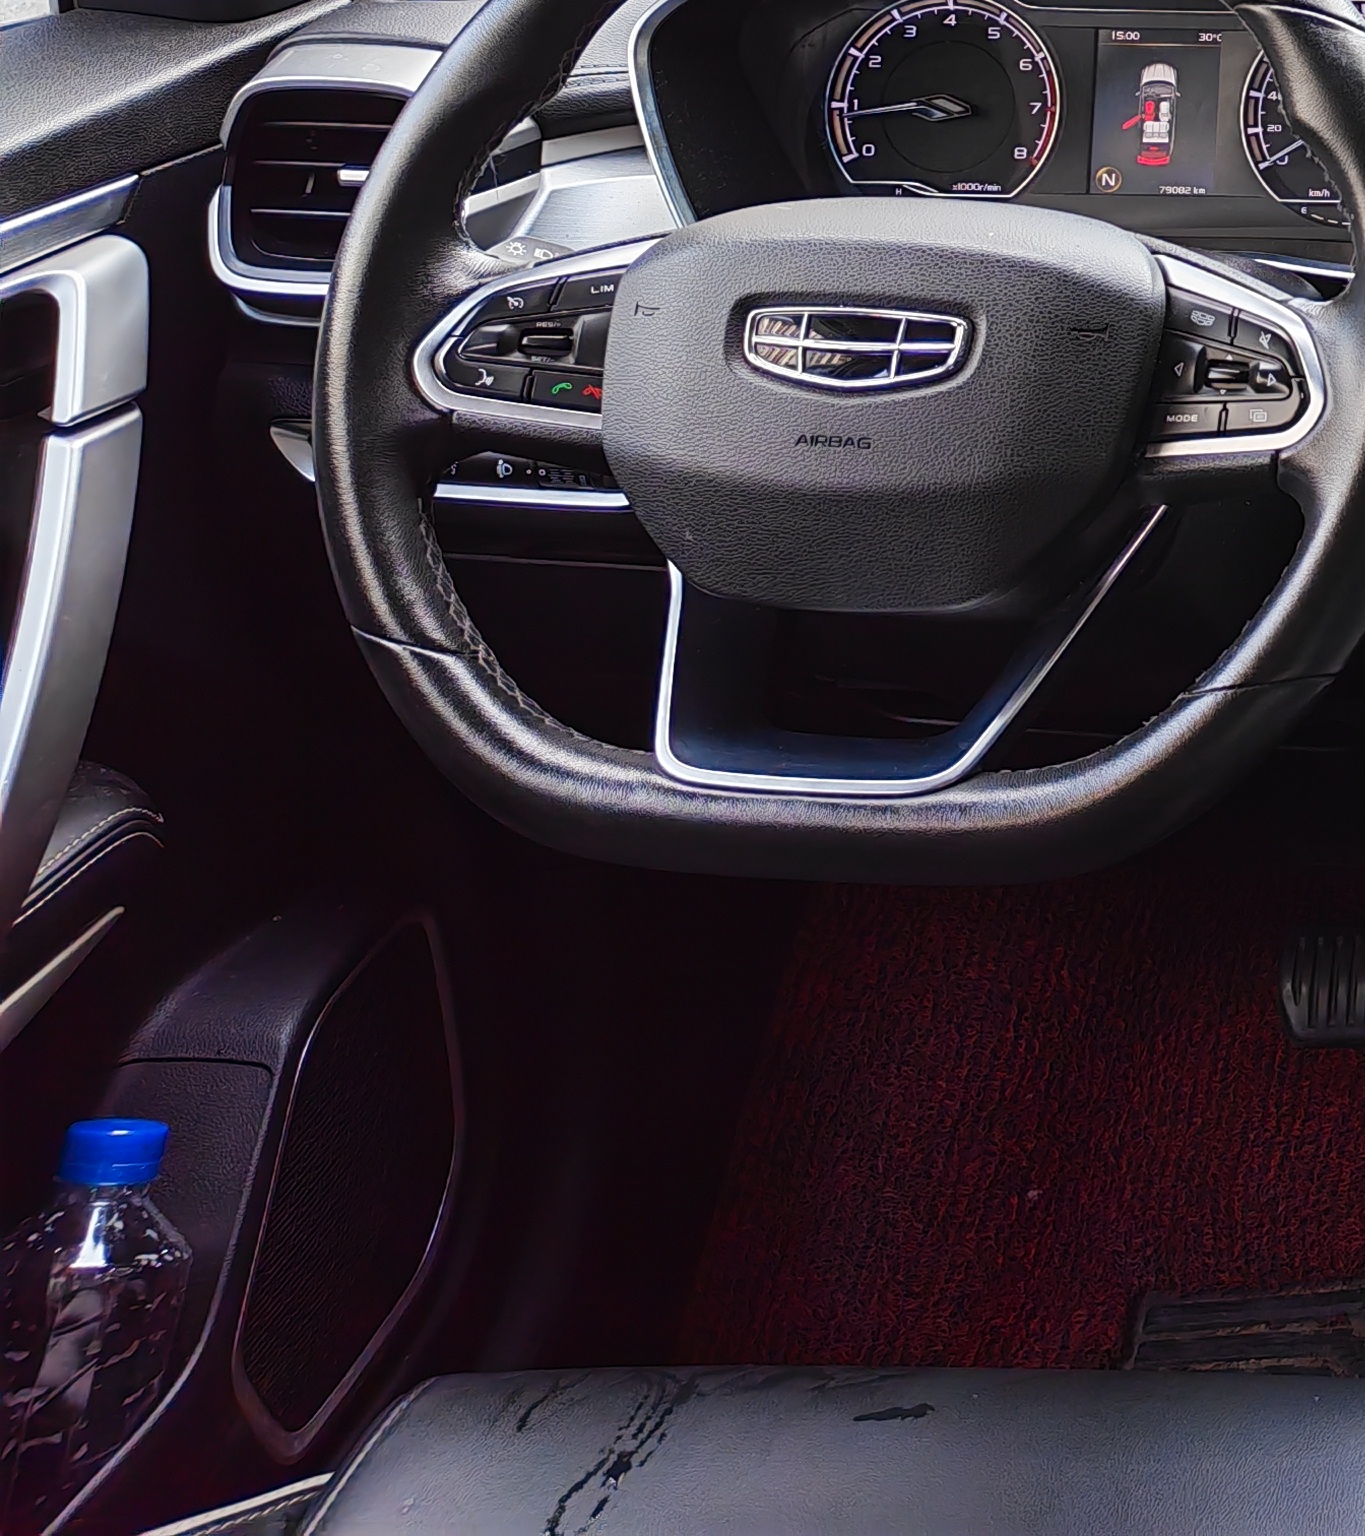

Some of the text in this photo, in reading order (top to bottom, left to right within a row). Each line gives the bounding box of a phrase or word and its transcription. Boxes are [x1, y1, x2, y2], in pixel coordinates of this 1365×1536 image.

[943, 14, 957, 26] 4
[903, 26, 917, 38] 3
[988, 27, 1001, 39] 5
[868, 56, 882, 68] 2
[1019, 59, 1033, 71] 6
[852, 98, 859, 111] 1
[1029, 102, 1042, 114] 7
[1266, 124, 1282, 132] 20
[862, 144, 875, 156] 0
[1014, 147, 1027, 159] 8
[1101, 173, 1116, 186] N
[895, 186, 902, 196] H
[1159, 185, 1206, 195] 79082 km
[1308, 189, 1331, 197] km/h
[590, 284, 614, 294] LIM
[1166, 414, 1199, 423] MODE
[795, 434, 873, 450] AIRBAG
